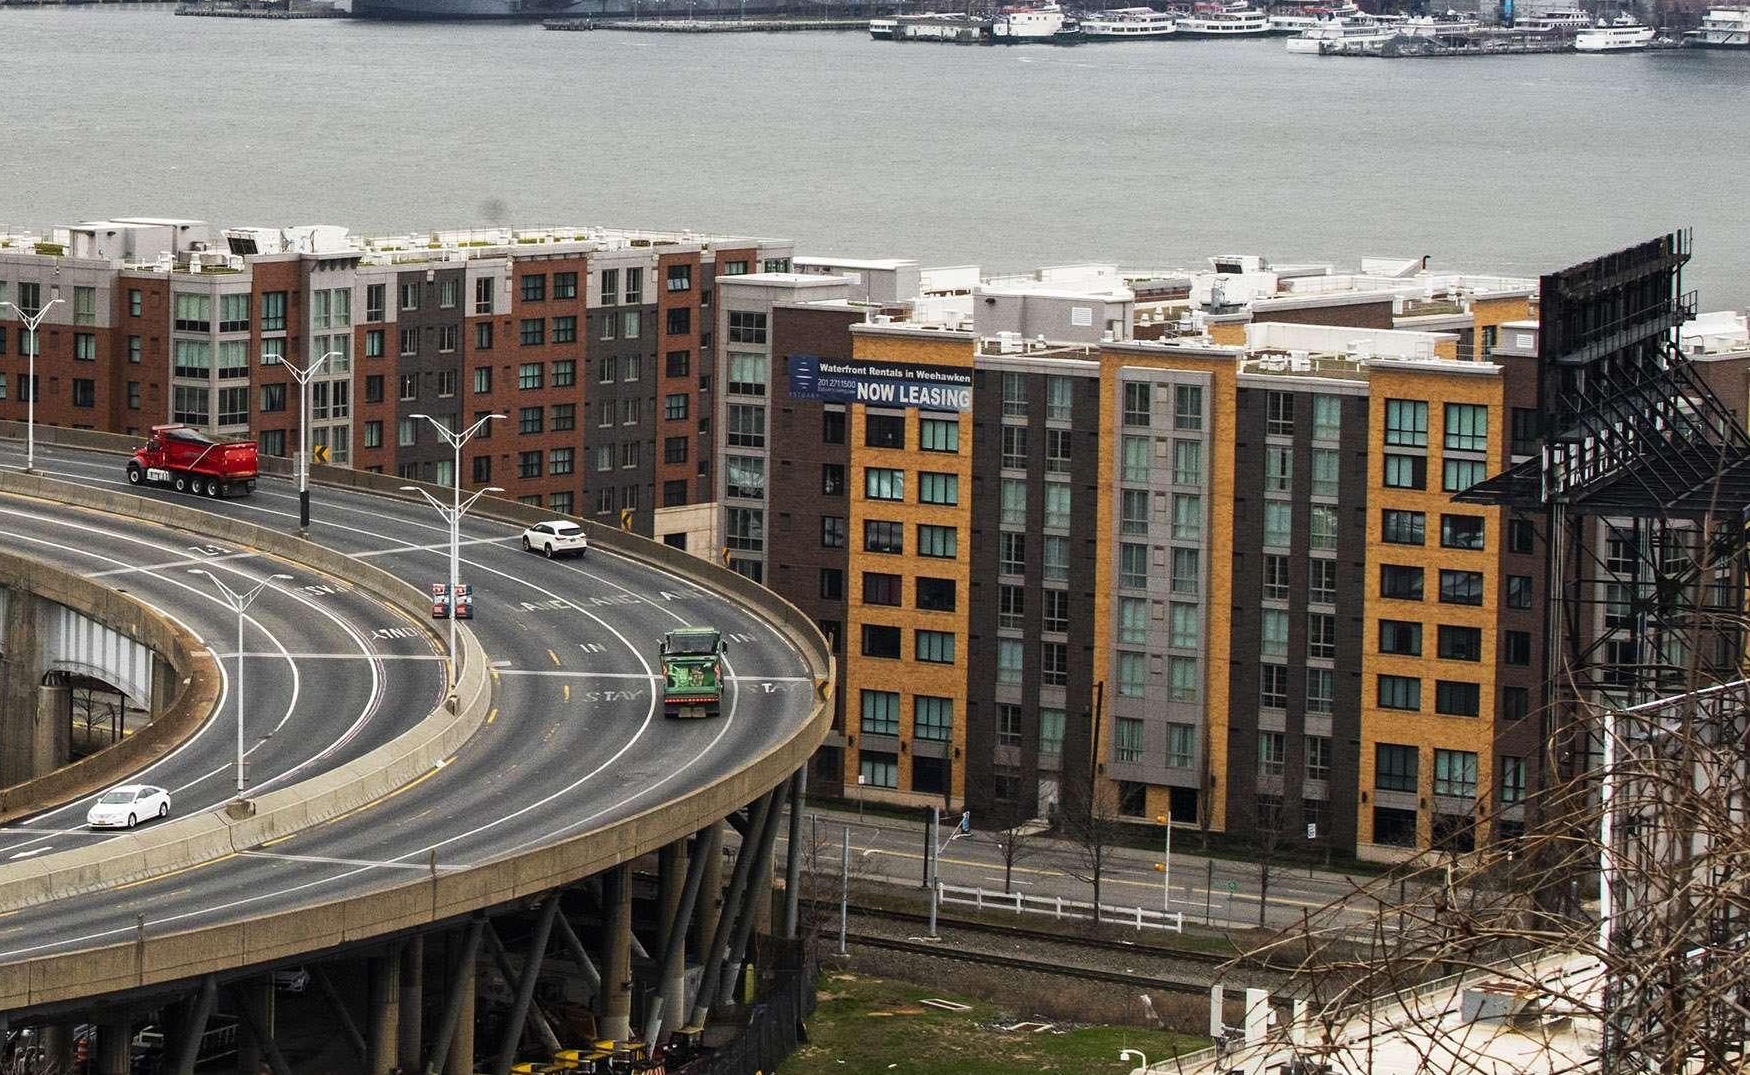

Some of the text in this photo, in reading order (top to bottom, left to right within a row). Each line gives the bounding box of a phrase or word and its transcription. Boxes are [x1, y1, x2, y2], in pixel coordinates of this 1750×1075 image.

[819, 363, 971, 383] Waterfront Rentals in Weehawken
[857, 382, 894, 402] NOW
[900, 385, 971, 407] LEASING
[371, 628, 418, 640] ONLY
[584, 689, 642, 702] STAY
